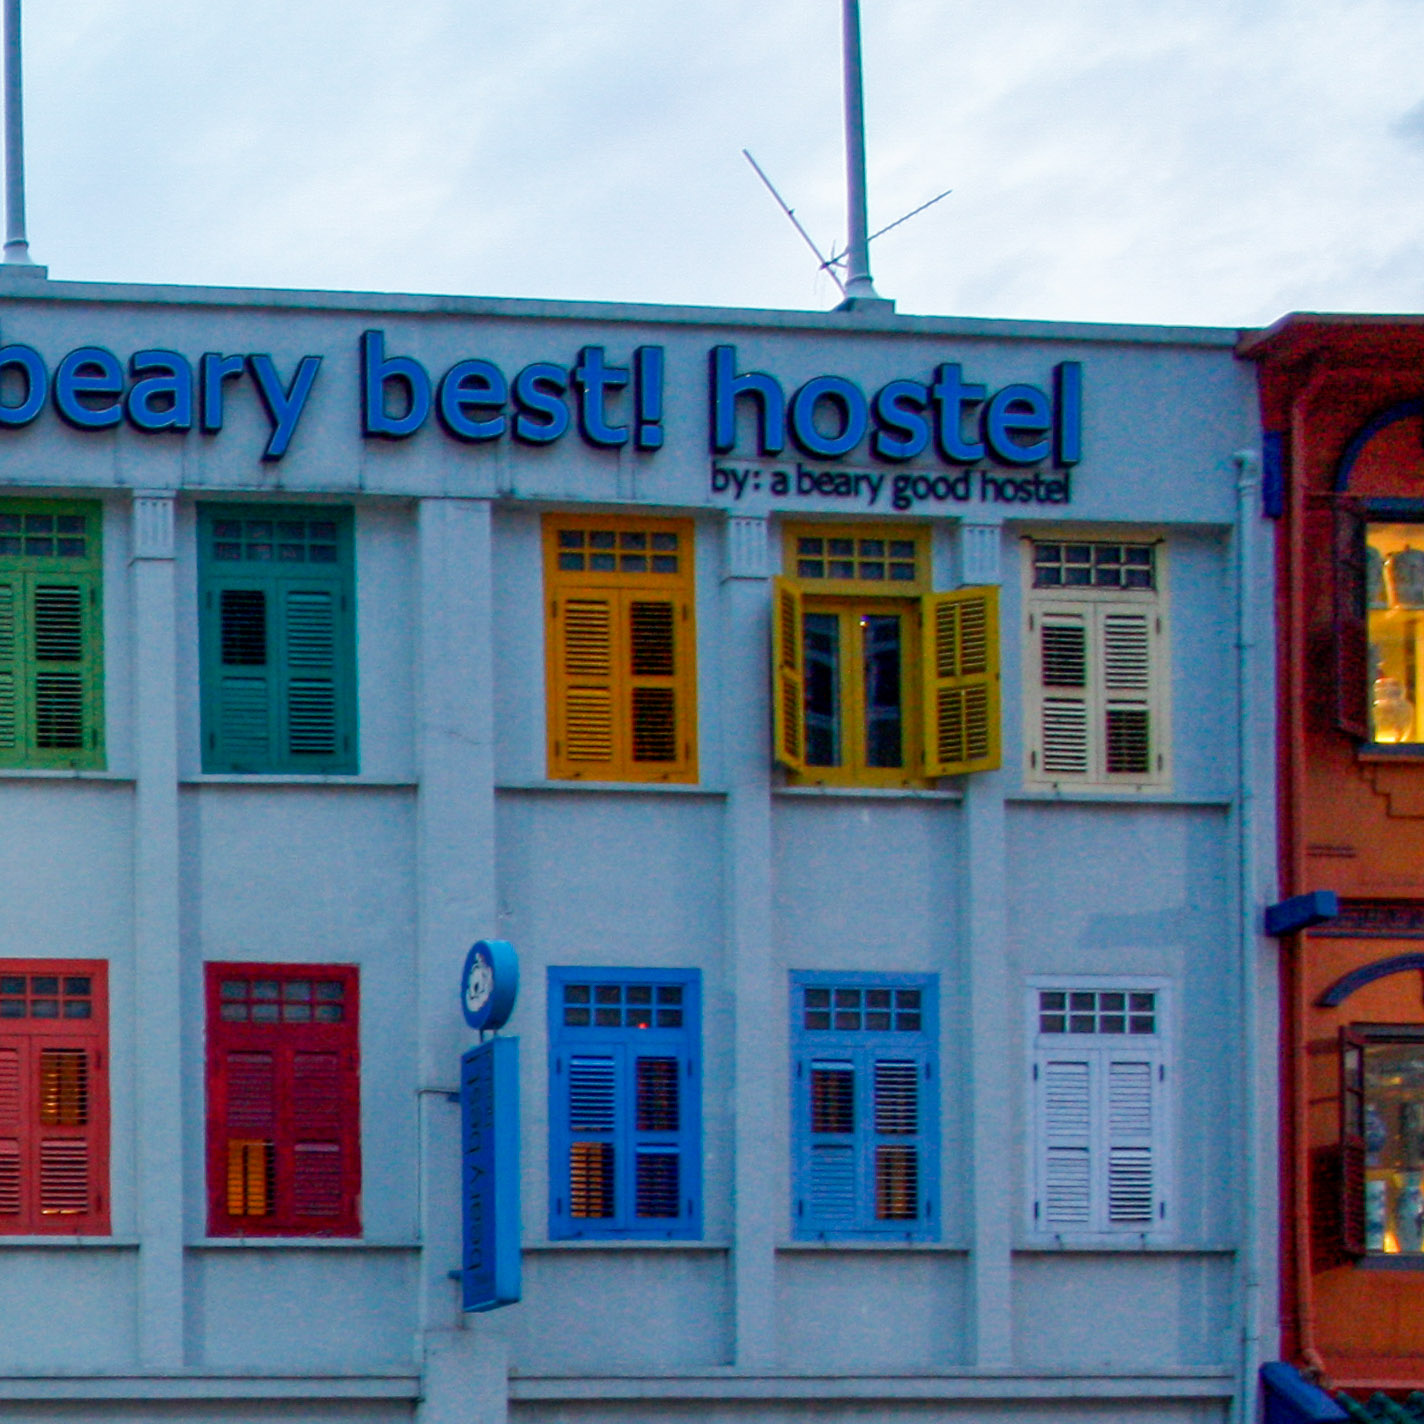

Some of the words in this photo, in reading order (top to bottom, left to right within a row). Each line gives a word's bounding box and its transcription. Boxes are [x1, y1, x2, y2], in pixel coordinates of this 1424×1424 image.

[359, 330, 663, 452] best!
[709, 345, 1082, 467] hostel
[712, 463, 761, 499] by:
[770, 471, 789, 495] a
[797, 463, 885, 506] beary
[892, 470, 970, 511] good
[981, 470, 1072, 504] hostel
